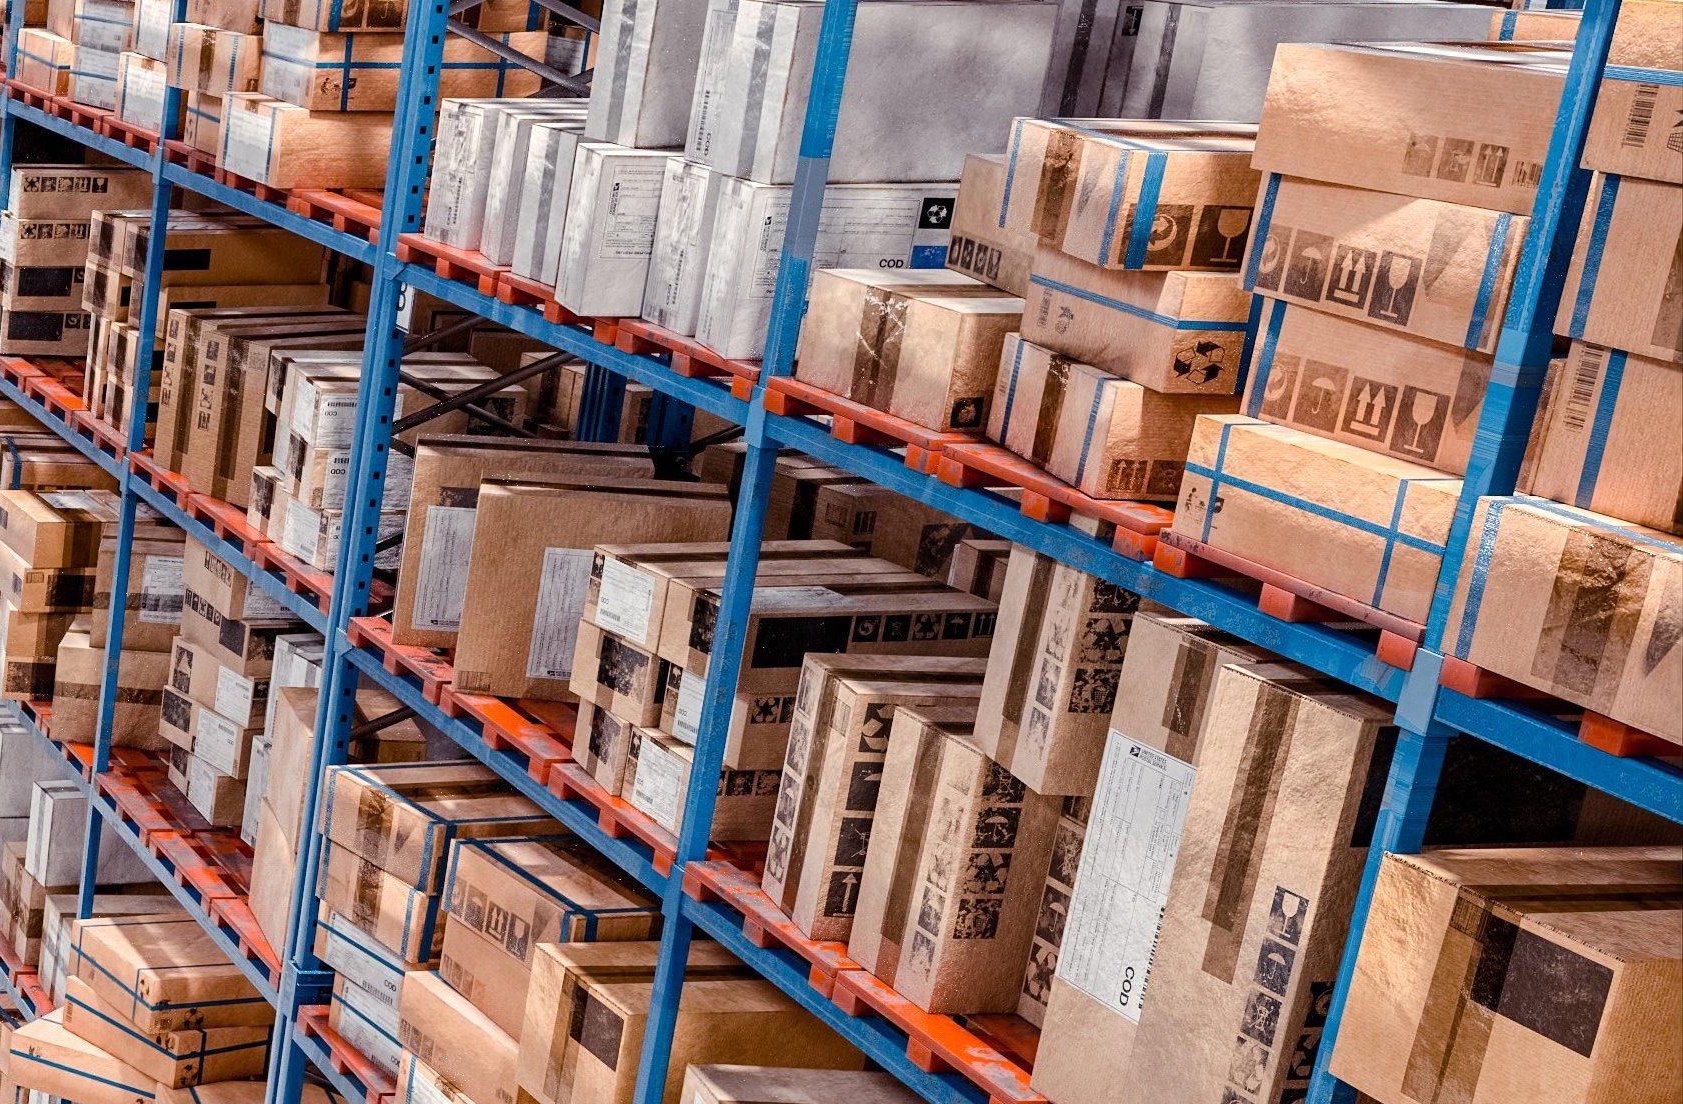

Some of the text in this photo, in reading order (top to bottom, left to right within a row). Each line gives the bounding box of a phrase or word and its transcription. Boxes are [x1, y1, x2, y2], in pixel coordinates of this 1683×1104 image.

[879, 259, 903, 269] COD
[384, 979, 397, 992] COD
[1119, 965, 1135, 1007] COD
